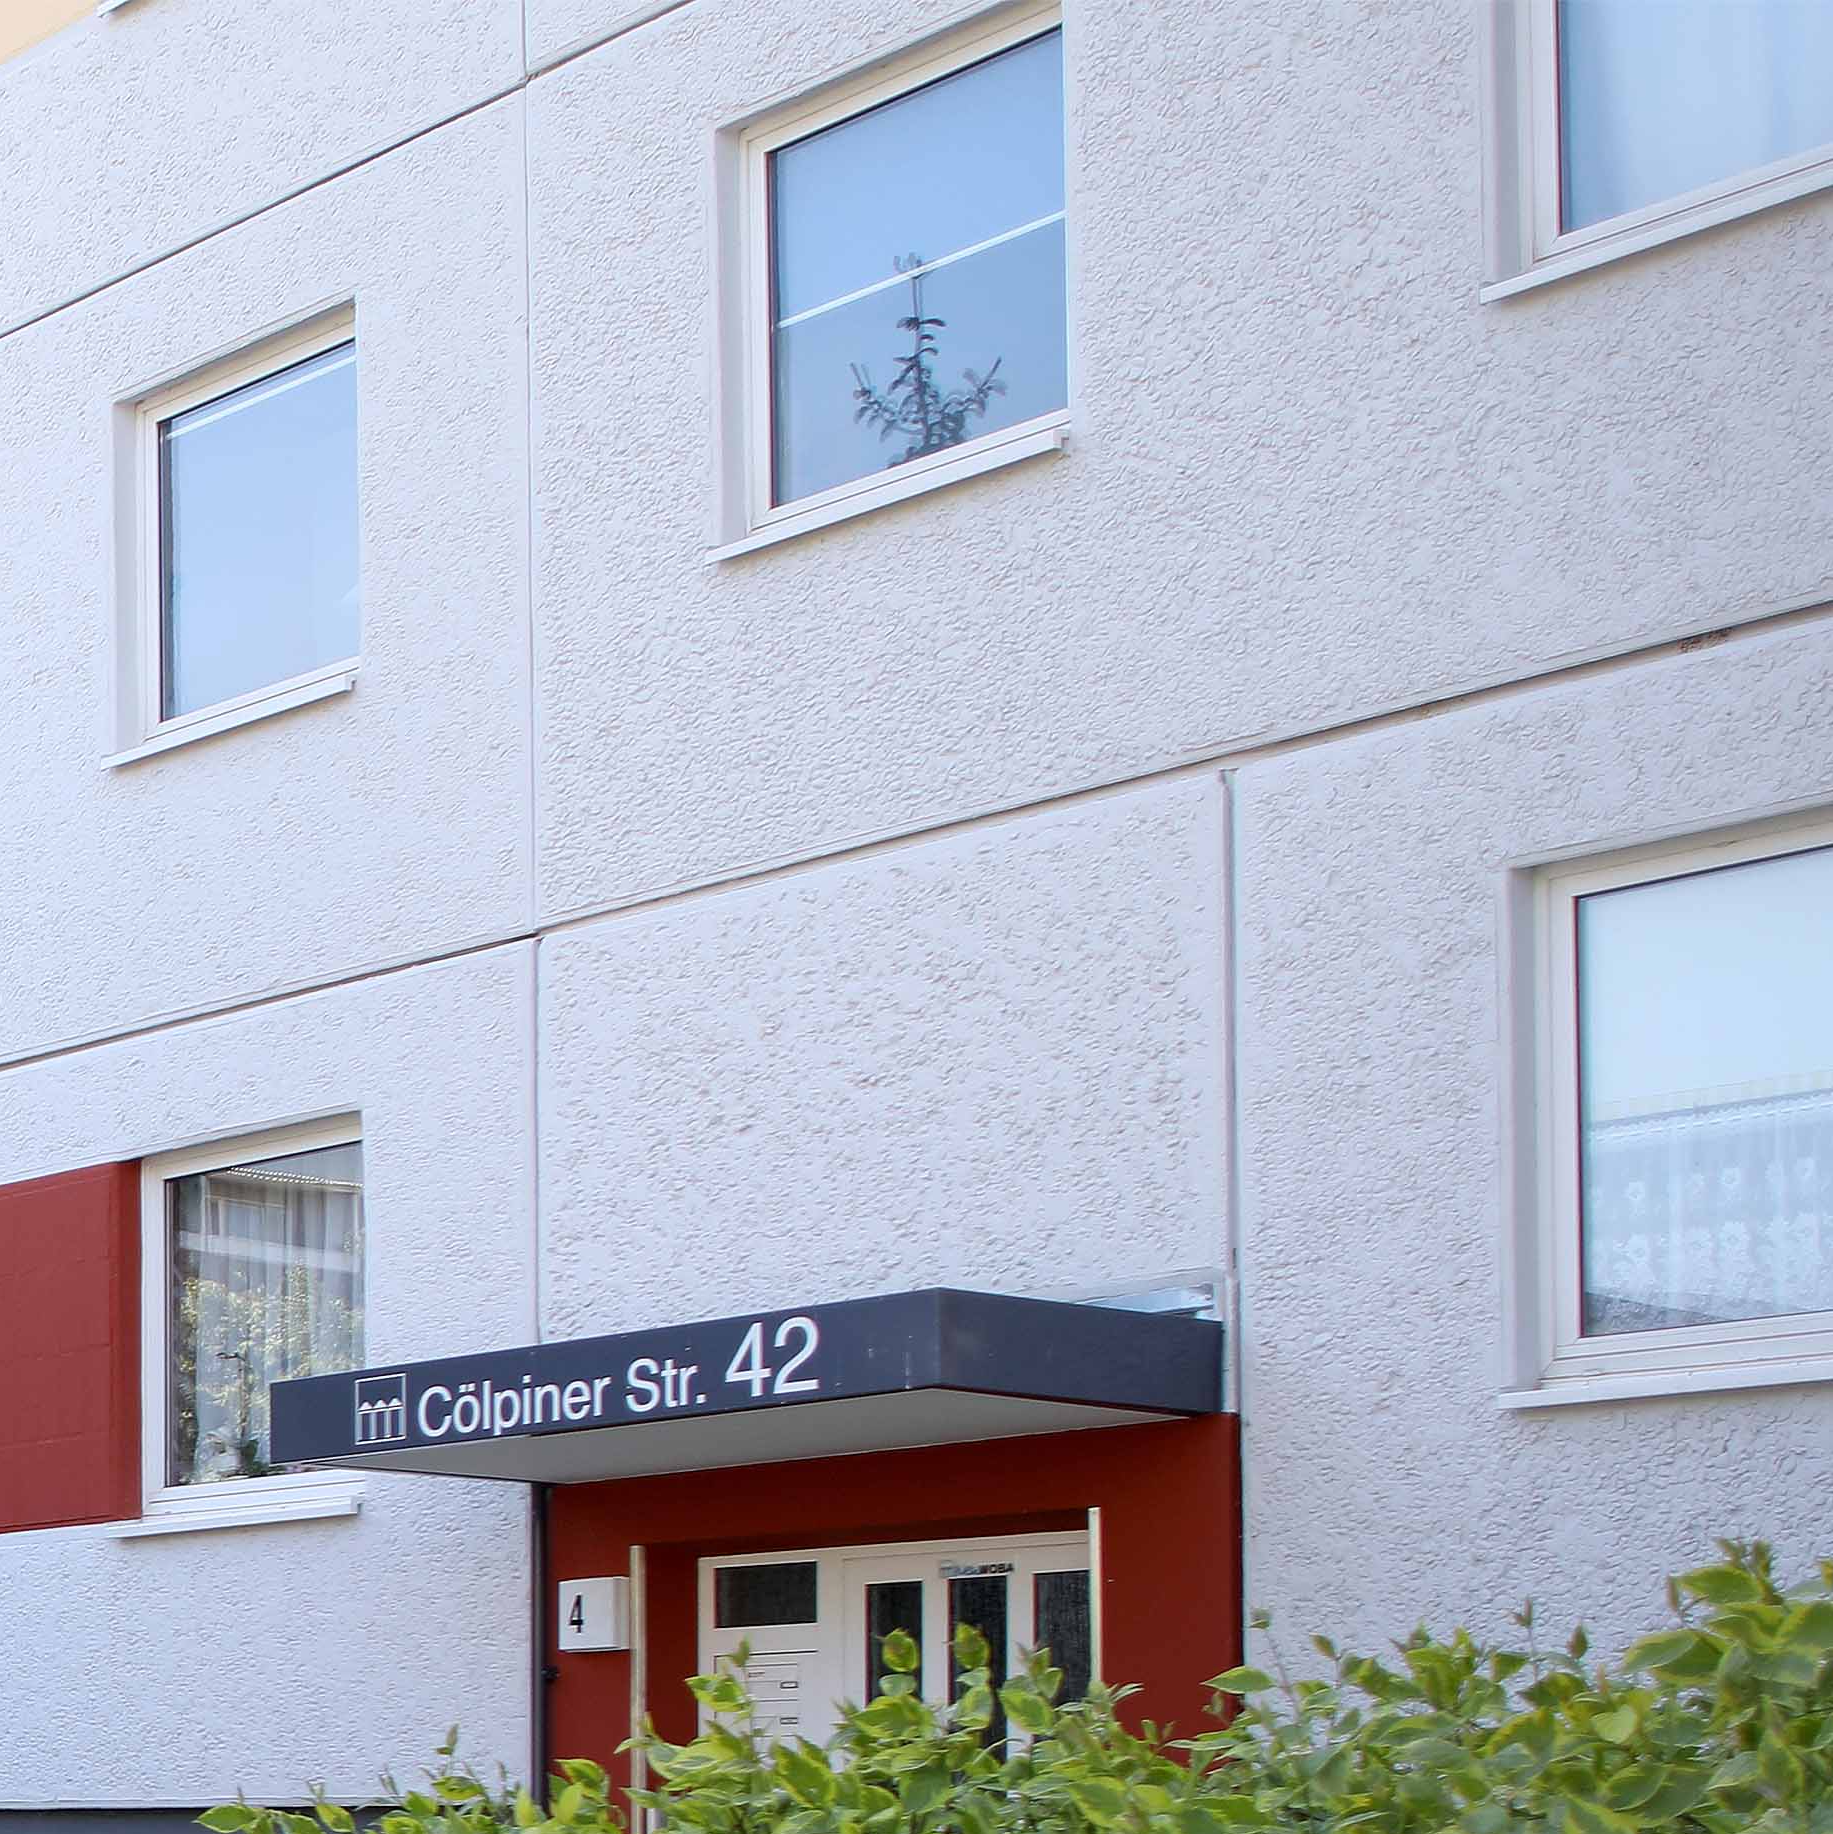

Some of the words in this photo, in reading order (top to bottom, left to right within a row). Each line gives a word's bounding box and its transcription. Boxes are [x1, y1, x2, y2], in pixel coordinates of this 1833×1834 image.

[418, 1374, 612, 1437] Cölpiner
[625, 1357, 709, 1414] Str.
[724, 1315, 821, 1398] 42
[568, 1594, 585, 1634] 4
